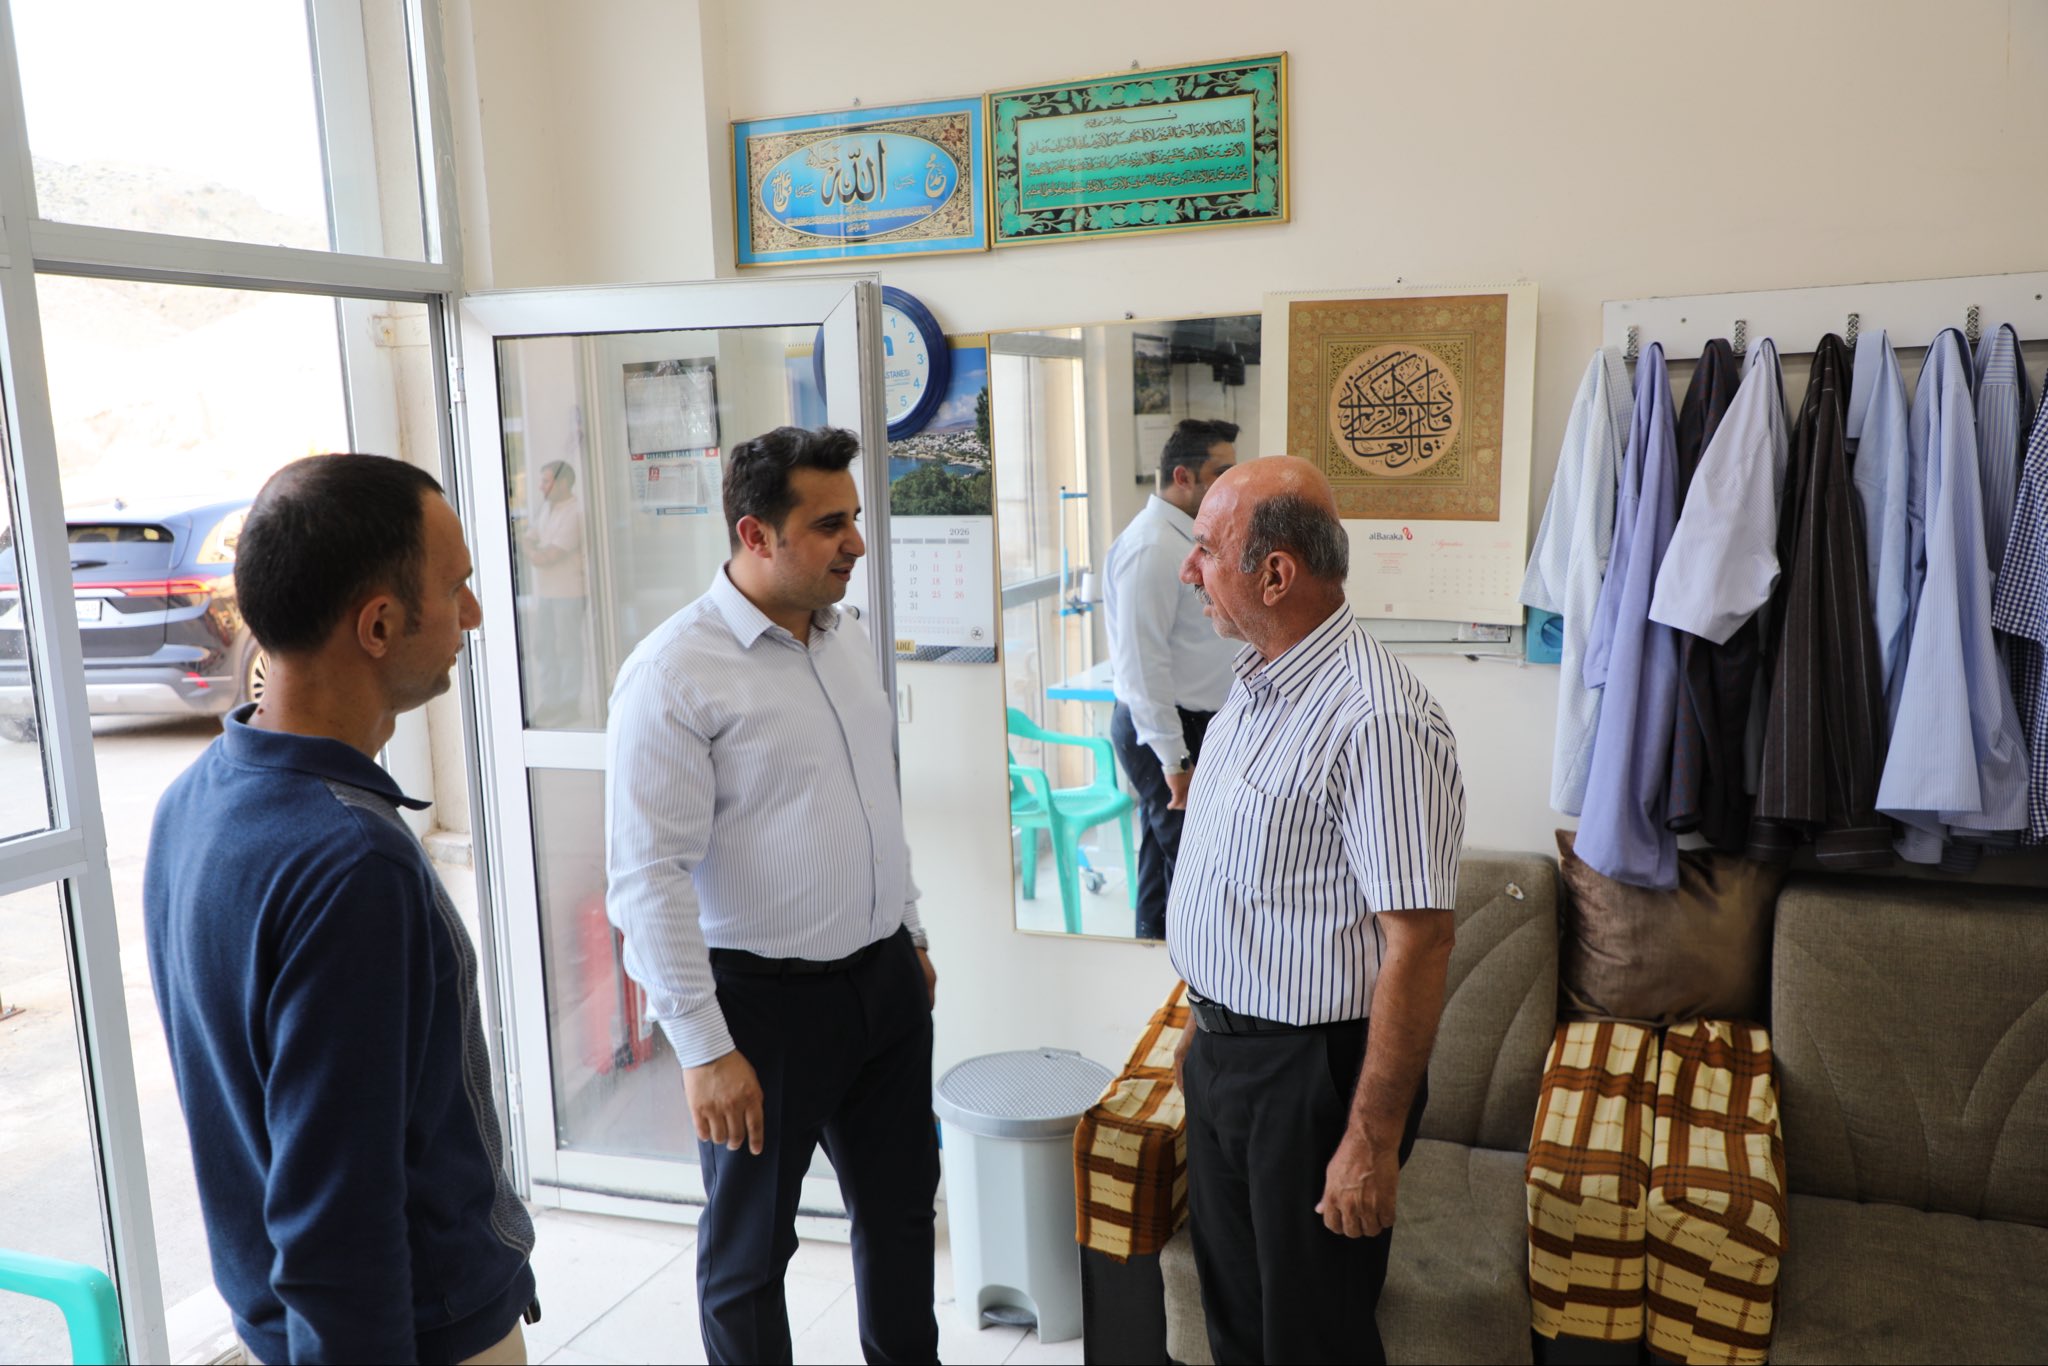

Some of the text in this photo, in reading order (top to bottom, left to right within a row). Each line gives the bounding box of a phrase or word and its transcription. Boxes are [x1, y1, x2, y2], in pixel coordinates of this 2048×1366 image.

[821, 138, 887, 207] الله
[890, 317, 896, 328] 1
[907, 331, 915, 343] 2
[917, 353, 925, 365] 3
[913, 377, 920, 389] 4
[900, 395, 907, 407] 5
[949, 528, 970, 536] 2026
[1369, 532, 1404, 541] alBaraka
[909, 564, 964, 572] 10 11 12
[909, 577, 918, 585] 17
[908, 590, 918, 598] 24
[932, 591, 941, 599] 25
[909, 602, 918, 610] 31
